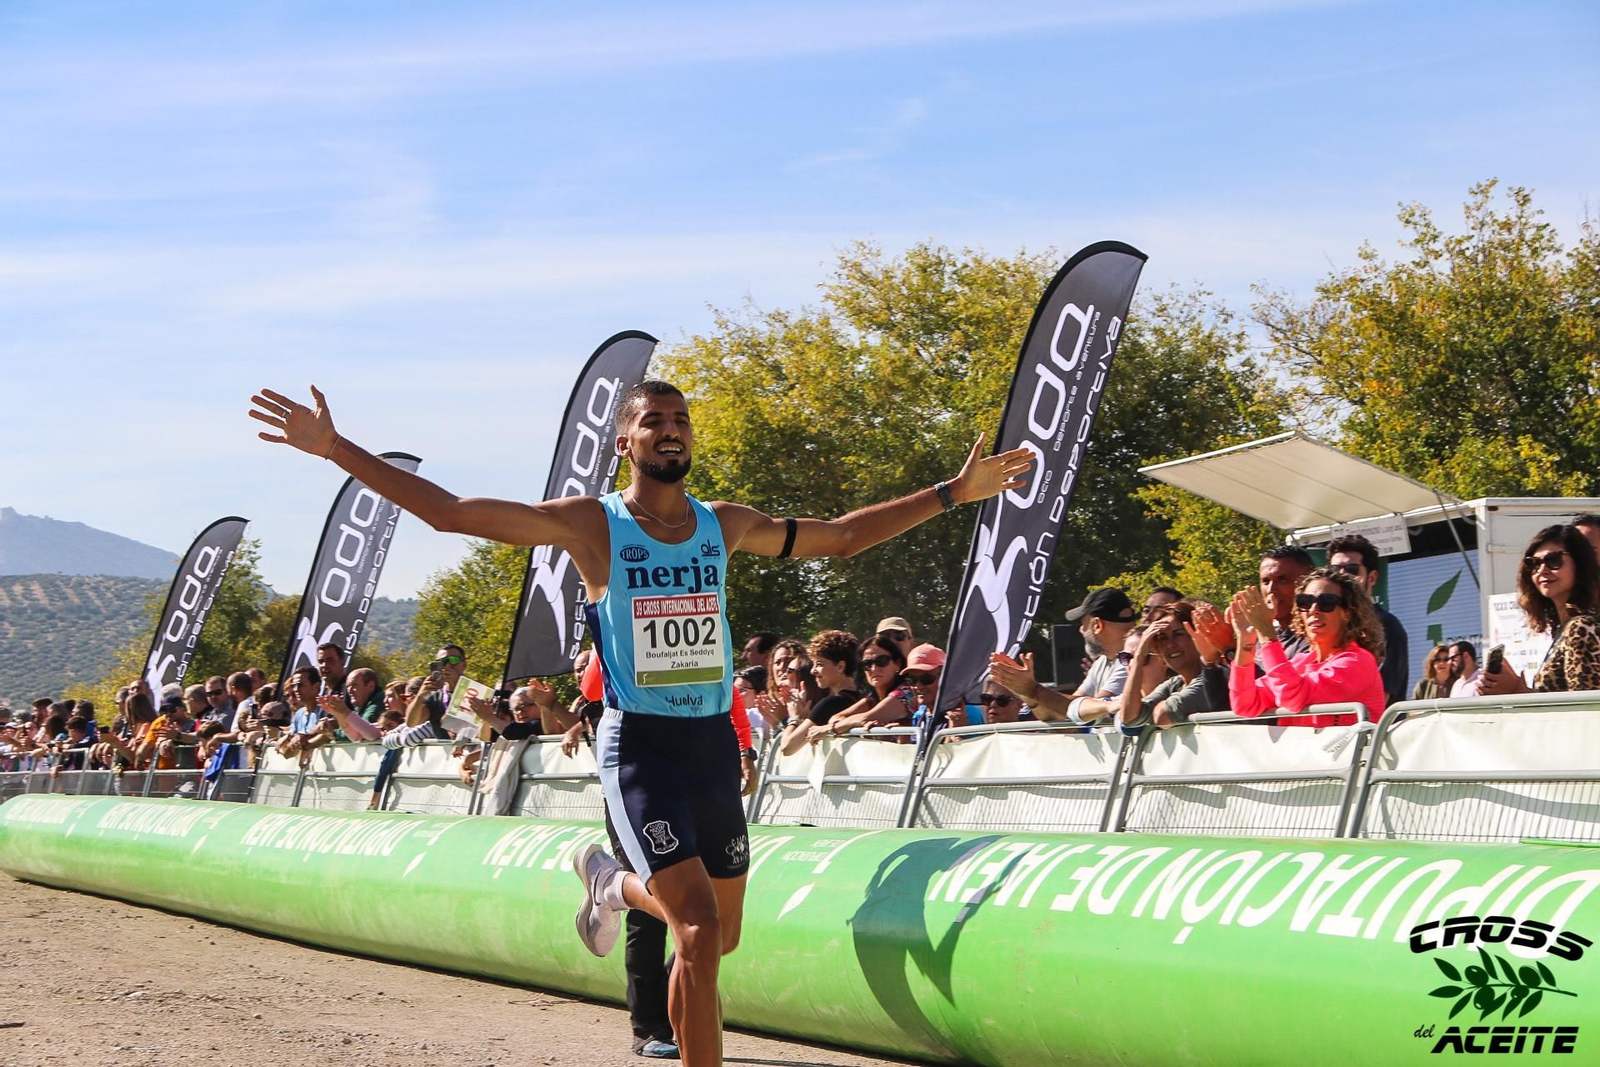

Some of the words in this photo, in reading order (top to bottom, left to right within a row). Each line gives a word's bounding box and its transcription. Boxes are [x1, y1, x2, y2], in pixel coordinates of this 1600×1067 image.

[621, 547, 649, 560] TROPS
[625, 557, 719, 593] nerja
[636, 601, 643, 616] 39
[643, 601, 660, 616] CROSS
[661, 599, 696, 614] INTERNACIONAL
[696, 598, 706, 612] DEL
[643, 617, 717, 649] 1002
[645, 651, 678, 659] Boufaljat
[671, 660, 699, 669] Zakaria
[482, 824, 580, 879] JAÉN
[929, 841, 1096, 923] JAÉN
[1050, 845, 1173, 915] DE
